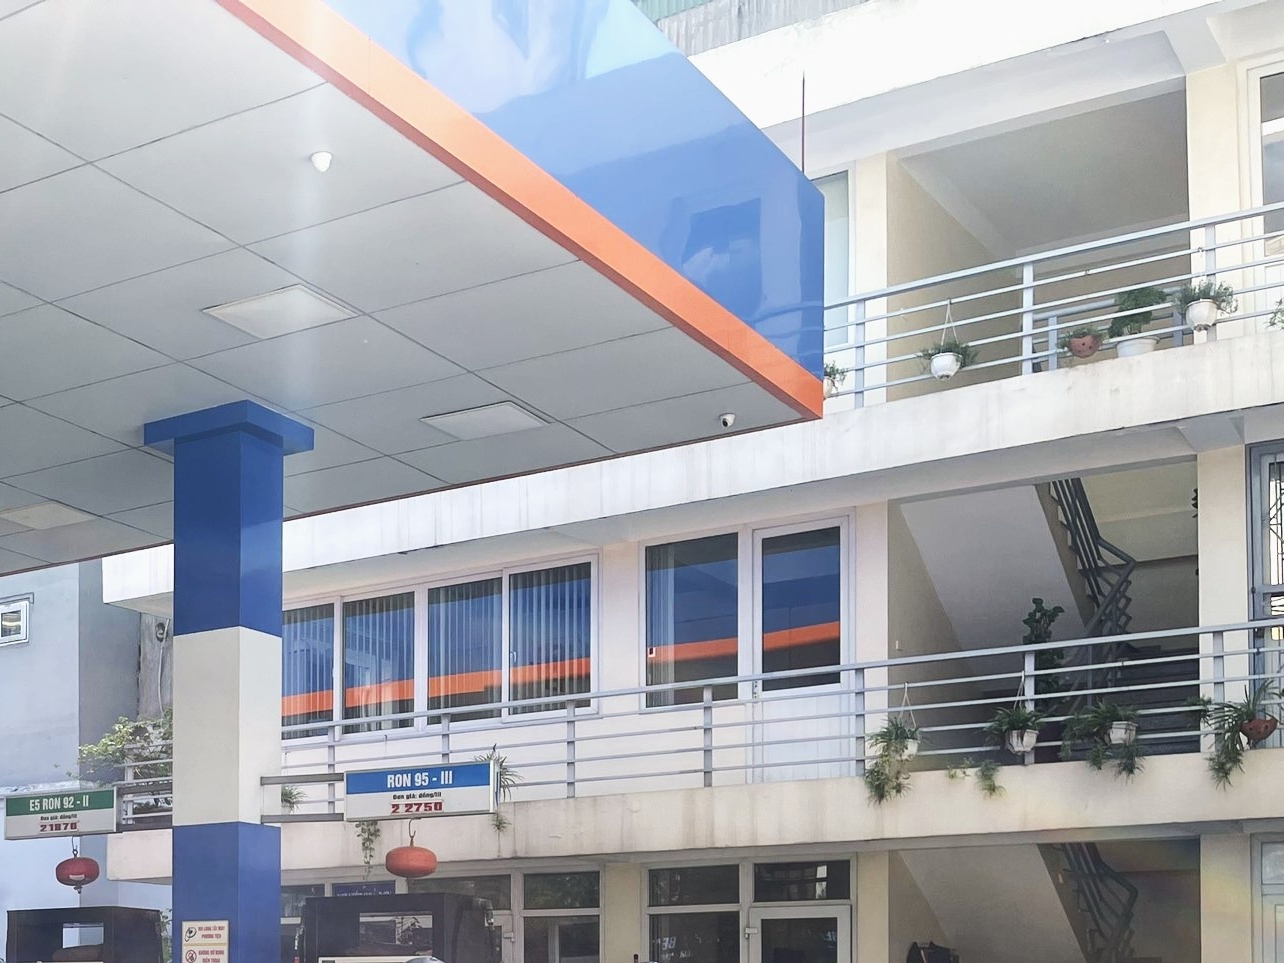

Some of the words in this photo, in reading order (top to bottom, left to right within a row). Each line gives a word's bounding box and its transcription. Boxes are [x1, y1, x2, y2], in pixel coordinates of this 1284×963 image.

[387, 774, 412, 789] RON
[414, 772, 429, 787] 95
[440, 770, 453, 785] III
[29, 798, 41, 812] E5
[42, 797, 61, 811] RON
[63, 796, 74, 809] 92
[82, 795, 89, 807] II
